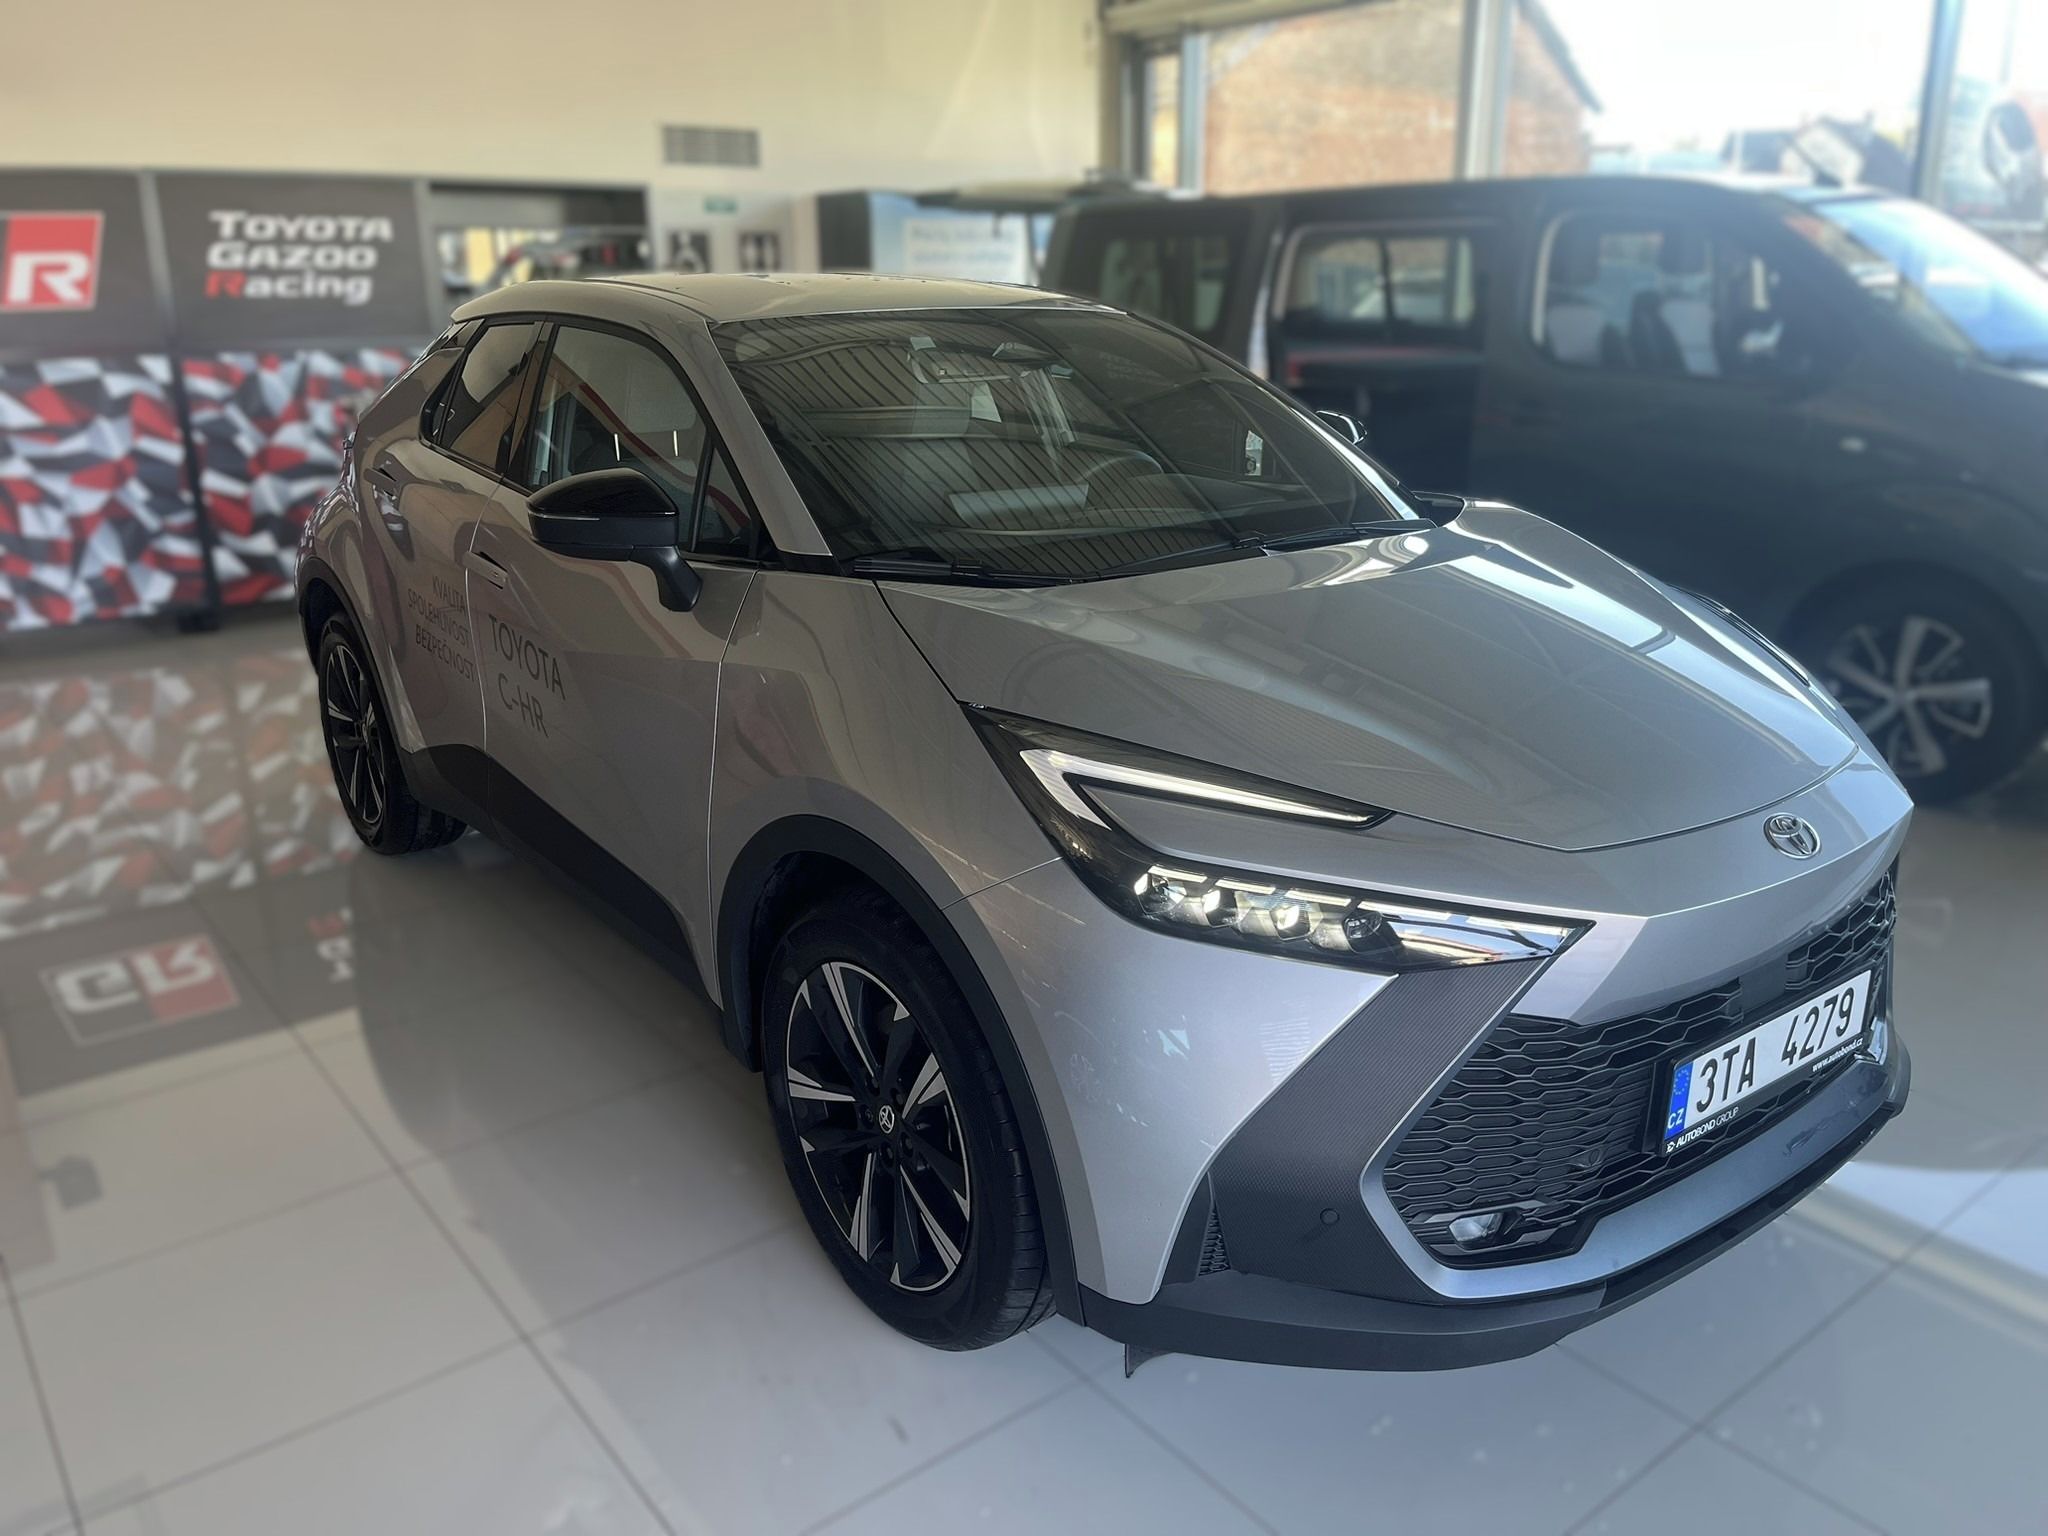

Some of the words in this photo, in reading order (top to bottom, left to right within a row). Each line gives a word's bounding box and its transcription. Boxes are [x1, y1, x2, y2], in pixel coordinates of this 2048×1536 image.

[208, 210, 393, 242] TOYOTA
[206, 240, 379, 270] GAZOO
[205, 269, 373, 306] Racing
[432, 575, 467, 616] KVALITA
[407, 587, 471, 649] SPOLEHLIVOST
[415, 623, 476, 682] BEZPEČNOST
[488, 613, 567, 701] TOYOTA
[498, 671, 549, 739] C-HR
[1695, 1036, 1757, 1114] 3TA
[1780, 986, 1855, 1066] 4279
[1812, 1037, 1864, 1073] www.autobond.cz
[1667, 1107, 1685, 1130] CZ
[1675, 1119, 1717, 1148] AUTOBOND
[1716, 1106, 1739, 1126] GROUP
